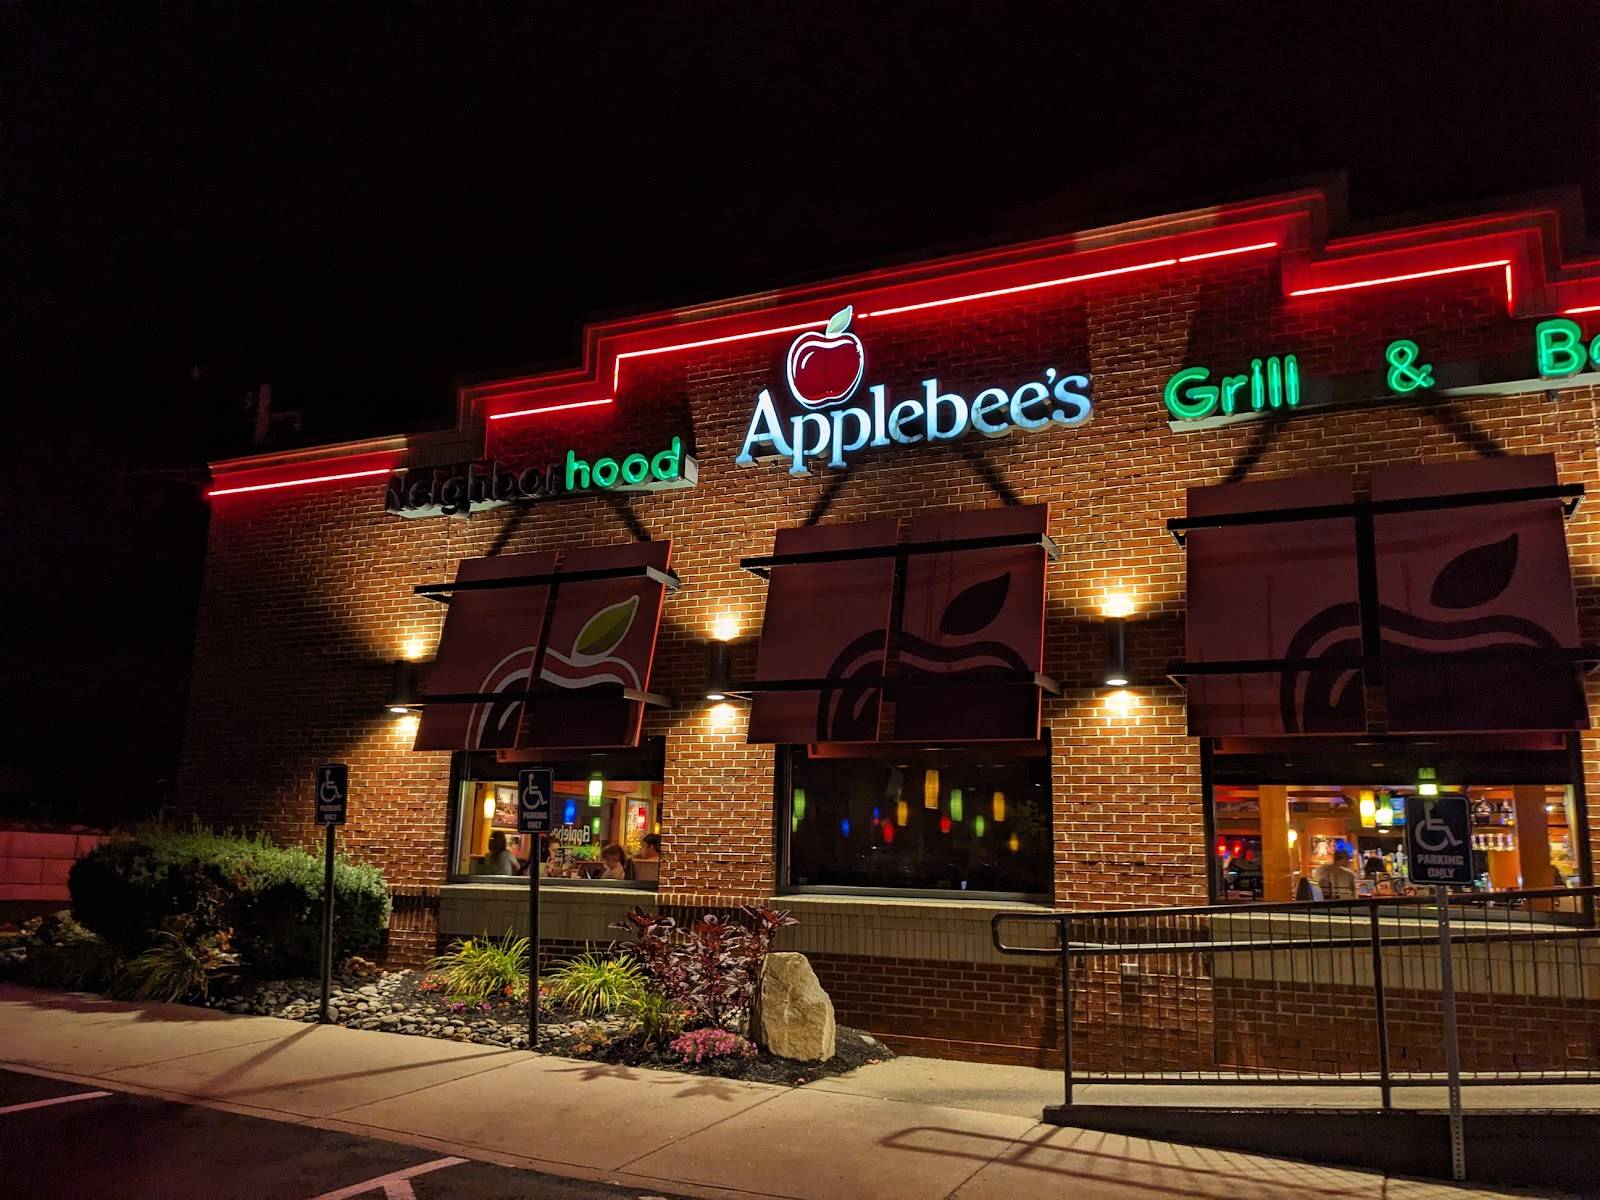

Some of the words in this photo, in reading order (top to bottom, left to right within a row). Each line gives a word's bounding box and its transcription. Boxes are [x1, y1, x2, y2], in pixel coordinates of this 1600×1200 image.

[1164, 354, 1299, 420] Grill
[1386, 339, 1435, 394] &
[1536, 319, 1600, 378] B
[735, 367, 1093, 477] Applebee's
[385, 436, 683, 516] Neighborhood
[1416, 854, 1464, 866] PARKING
[1427, 867, 1455, 879] ONLY
